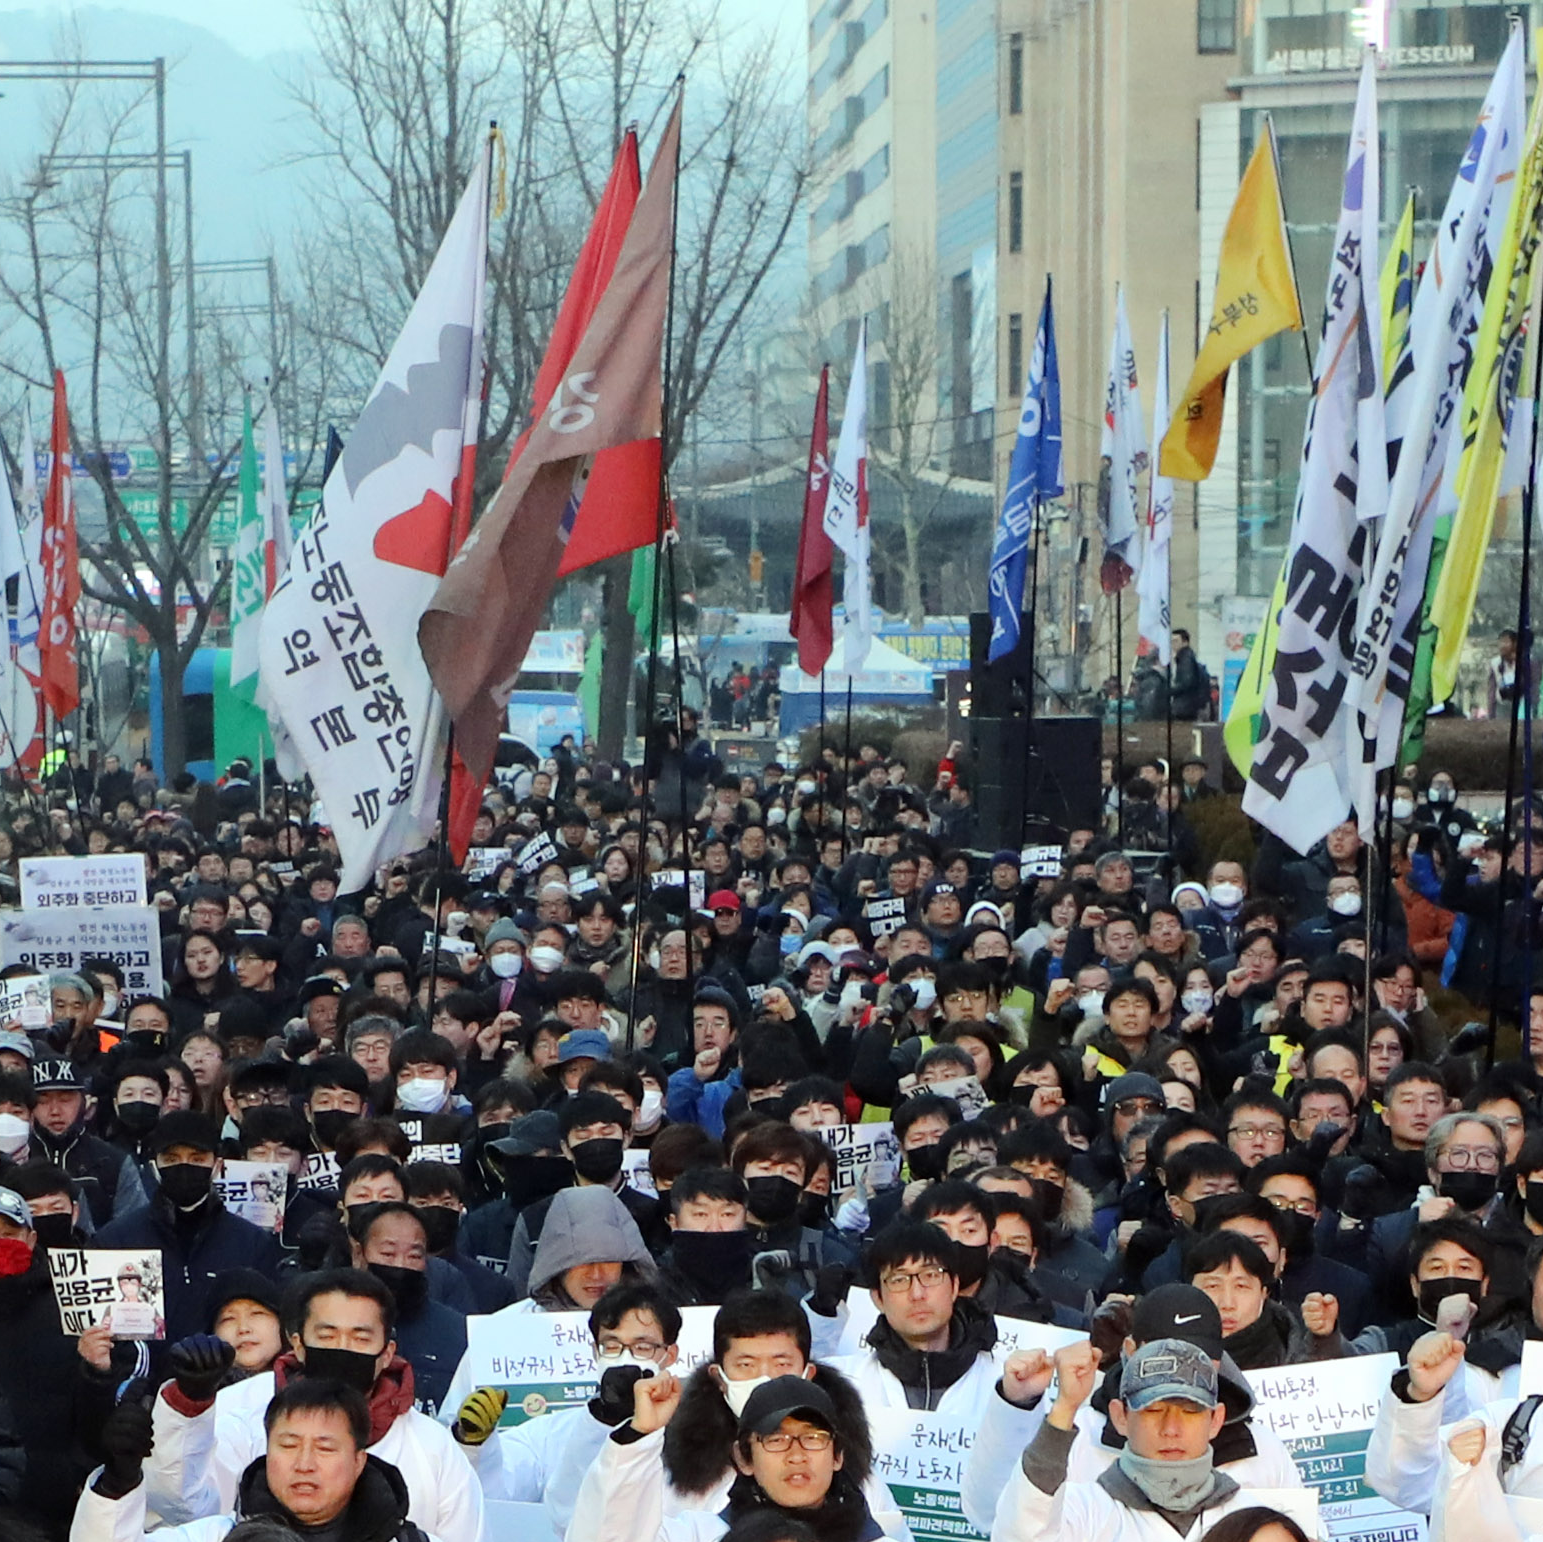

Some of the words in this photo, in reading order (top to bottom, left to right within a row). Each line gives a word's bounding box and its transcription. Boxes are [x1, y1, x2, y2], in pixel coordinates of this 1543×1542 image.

[37, 890, 79, 908] 외주화
[82, 888, 138, 906] 중단하고
[47, 1251, 89, 1278] 내가
[55, 1277, 117, 1306] 김용균
[492, 1356, 554, 1379] 비정규직
[916, 1457, 964, 1484] 노동자
